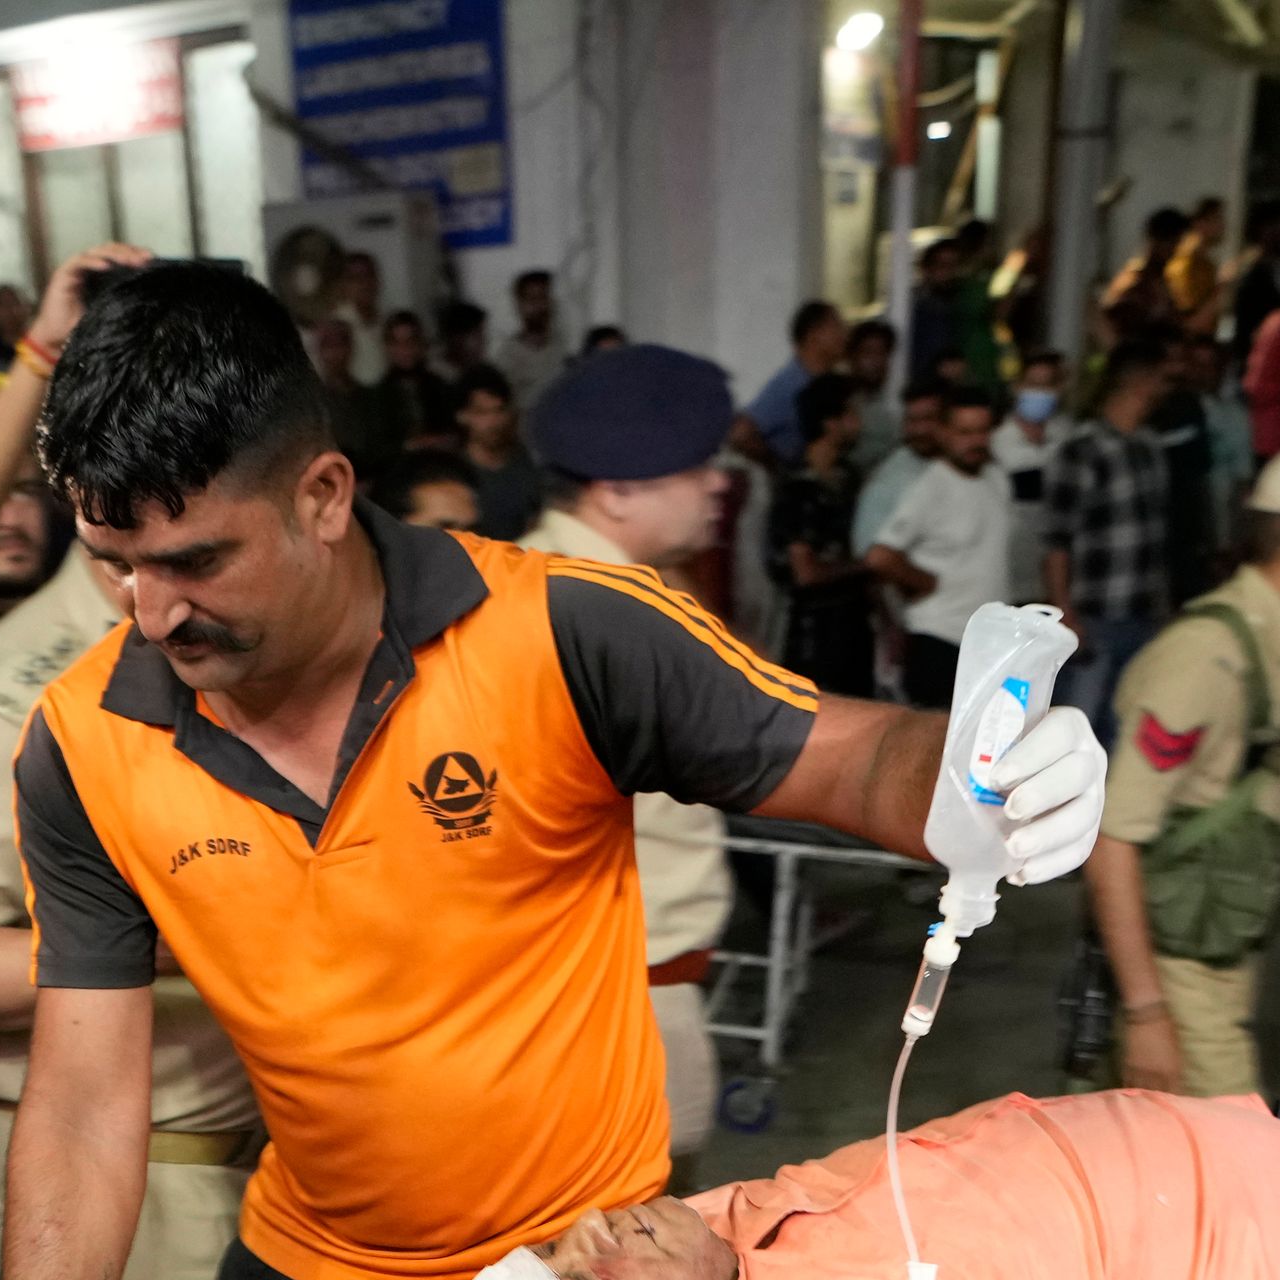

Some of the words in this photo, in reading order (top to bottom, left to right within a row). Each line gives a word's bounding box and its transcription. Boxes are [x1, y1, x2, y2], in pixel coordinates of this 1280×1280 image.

[441, 831, 464, 843] J&K
[465, 825, 493, 839] SDRF
[169, 842, 202, 874] J&K
[206, 838, 251, 857] SDRF
